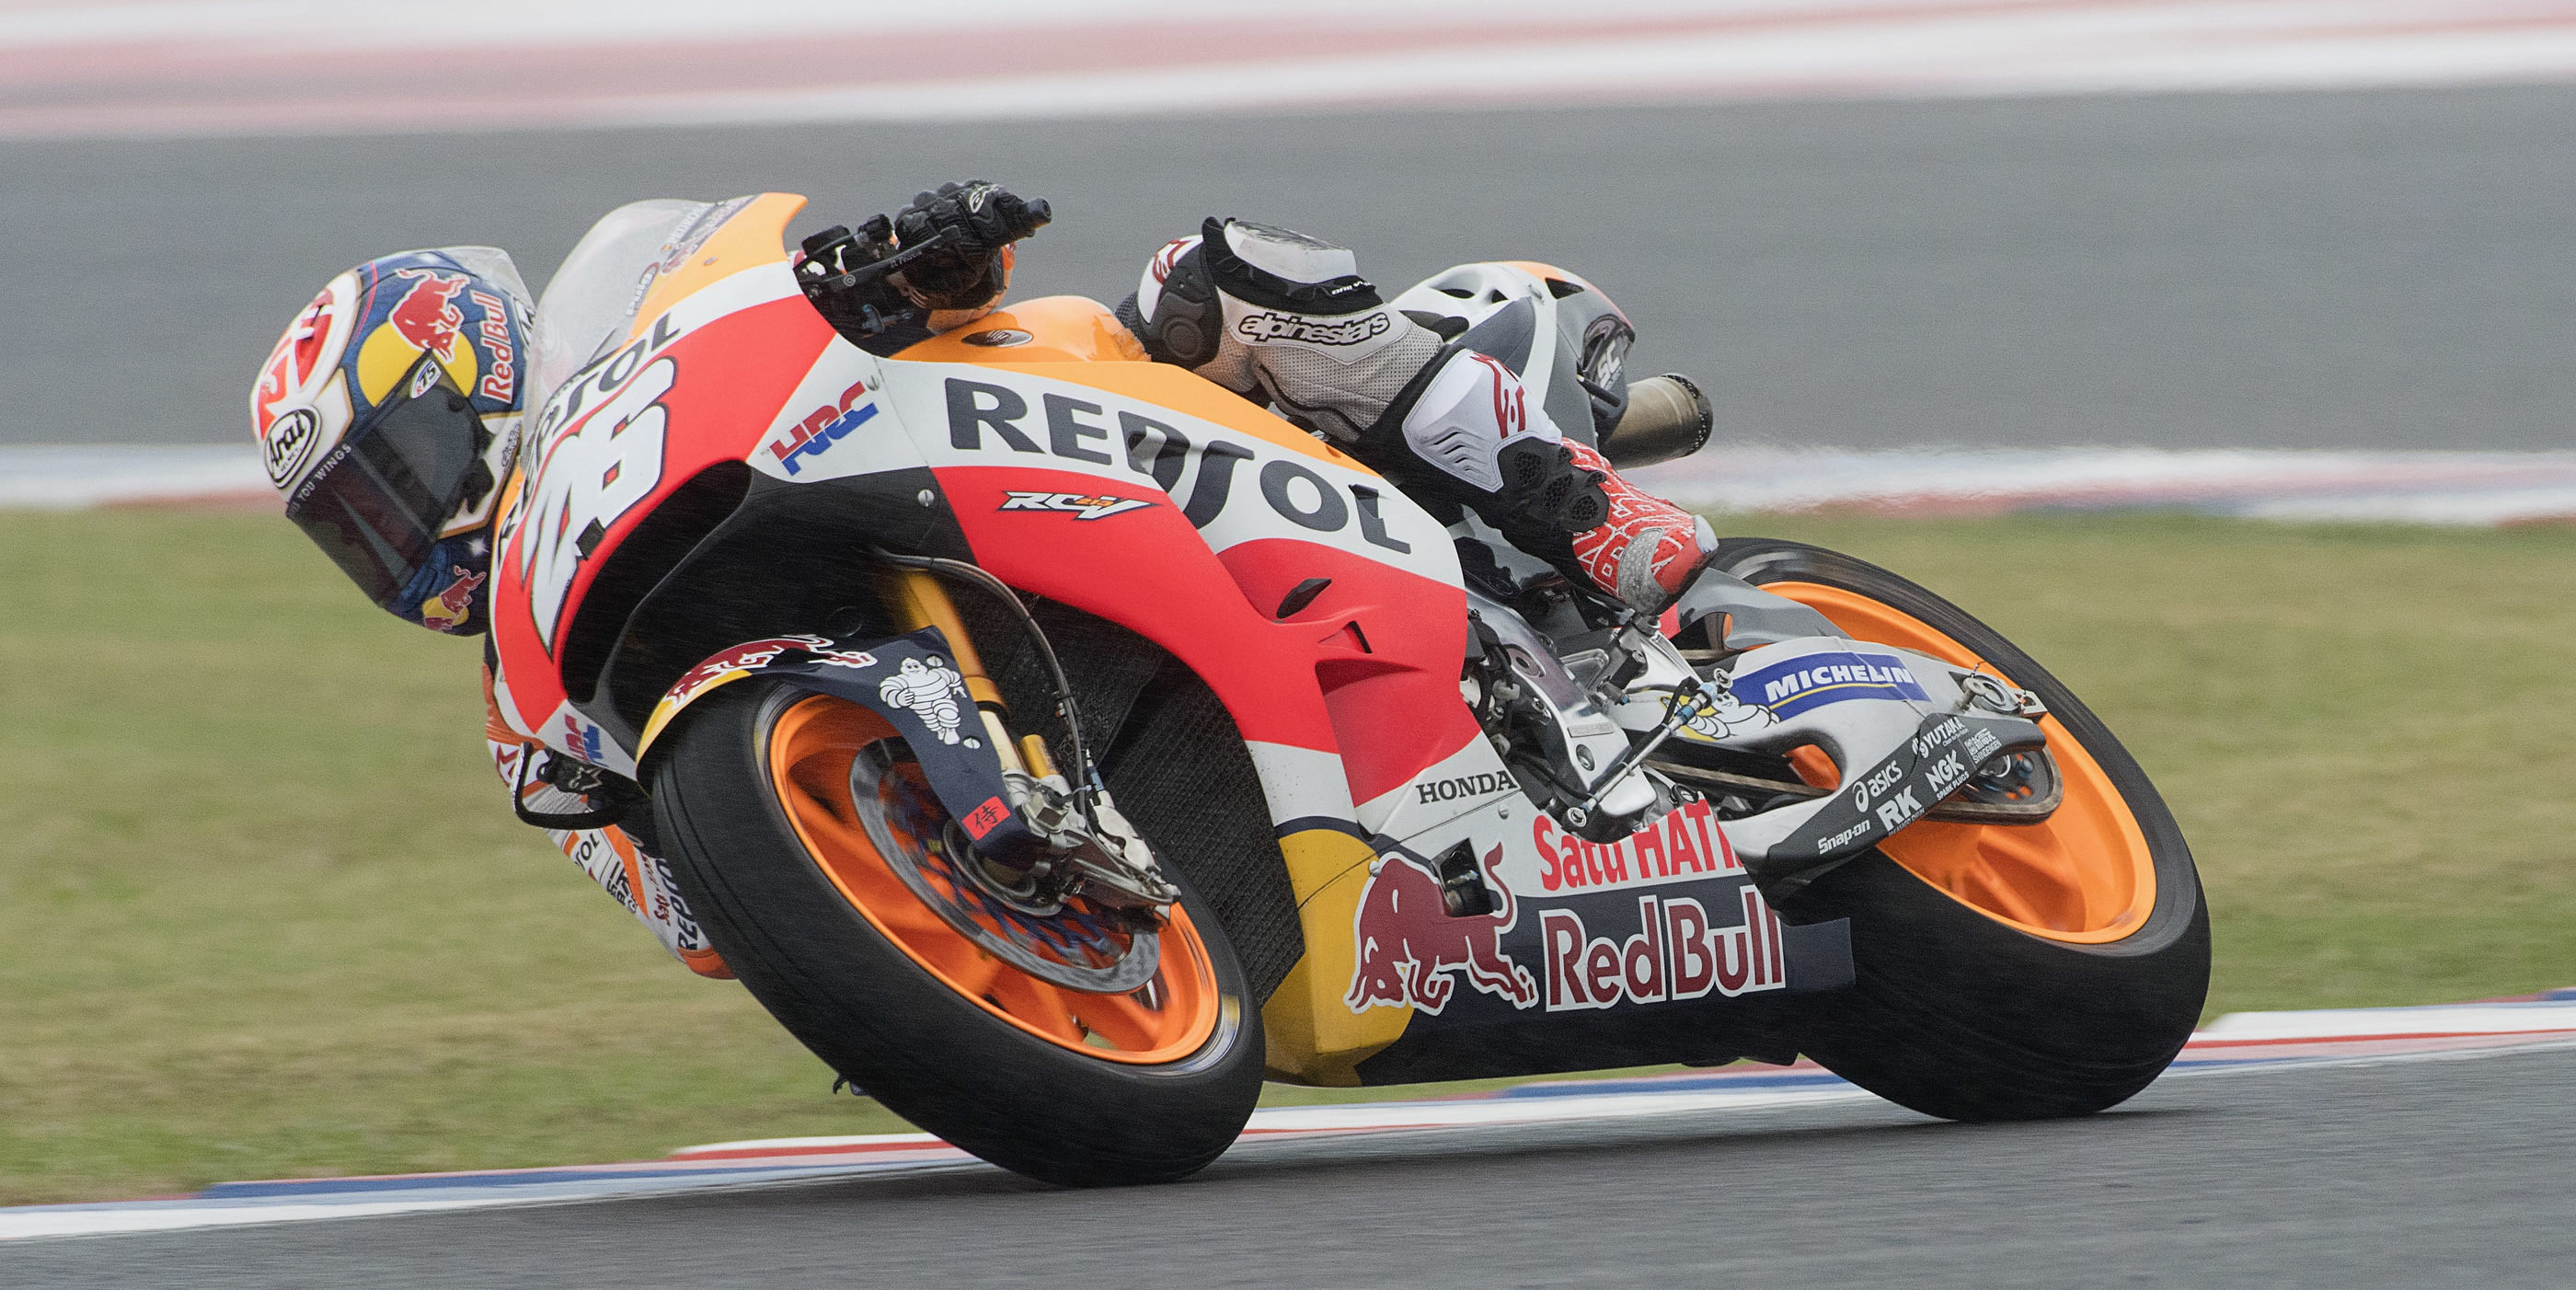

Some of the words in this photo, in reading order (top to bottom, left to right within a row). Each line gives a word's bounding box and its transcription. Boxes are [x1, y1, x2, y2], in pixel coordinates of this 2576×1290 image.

[1239, 312, 1390, 346] alpinestars
[269, 410, 305, 466] Arai
[769, 380, 880, 477] HRC
[315, 443, 351, 480] WINGS
[944, 377, 1411, 554] REPSOL
[522, 354, 678, 654] 26
[1765, 663, 1915, 703] MICHELIN
[1923, 716, 1966, 749] YUTAKA
[1415, 769, 1517, 804] HONDA
[1868, 760, 1903, 797] asics
[1926, 749, 1965, 792] NGK
[1936, 783, 1954, 800] SPARK
[1952, 771, 1970, 789] PLUGS
[974, 803, 999, 829] 侍
[1877, 785, 1923, 832] RK
[1533, 814, 1629, 891] Satu
[1818, 820, 1871, 855] Snap-on
[1538, 895, 1666, 1012] Red
[1664, 884, 1787, 997] Bull
